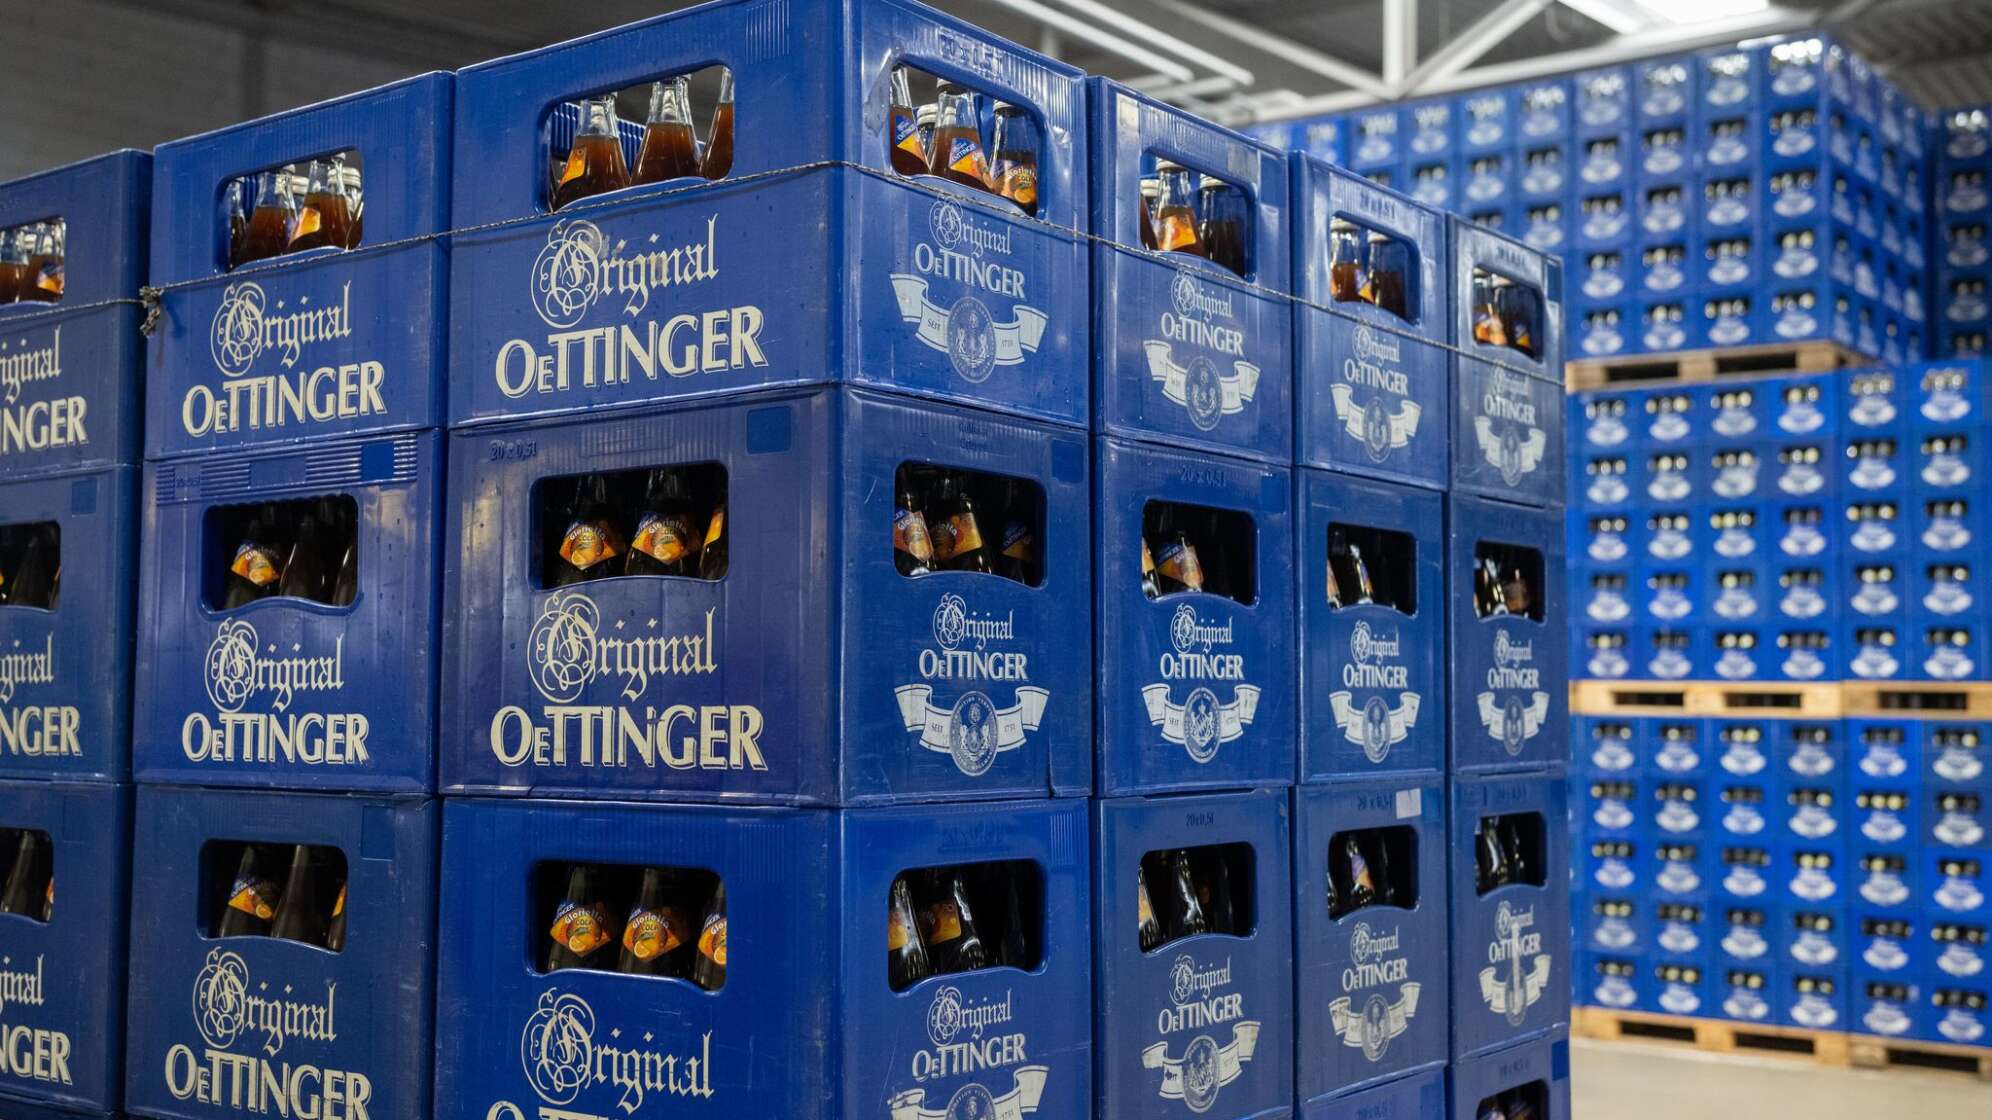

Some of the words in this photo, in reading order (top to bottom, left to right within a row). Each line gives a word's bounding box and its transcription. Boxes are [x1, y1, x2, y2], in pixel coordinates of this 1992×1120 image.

[929, 194, 1012, 257] Original
[531, 213, 719, 328] Original
[1171, 267, 1233, 321] Original
[211, 281, 352, 377] Original
[1352, 323, 1400, 368] Original
[0, 324, 62, 405] iginal
[527, 591, 718, 703] Original
[933, 592, 1015, 650] Original
[1171, 603, 1234, 653] Original
[1351, 620, 1400, 665] Original
[1494, 629, 1533, 668] Original
[204, 617, 345, 714] Original
[1351, 921, 1400, 966] Original
[1488, 932, 1541, 964] OETTGER
[192, 946, 337, 1056] Original
[1169, 954, 1233, 1006] Original
[927, 985, 1013, 1047] Original
[521, 987, 715, 1115] Original
